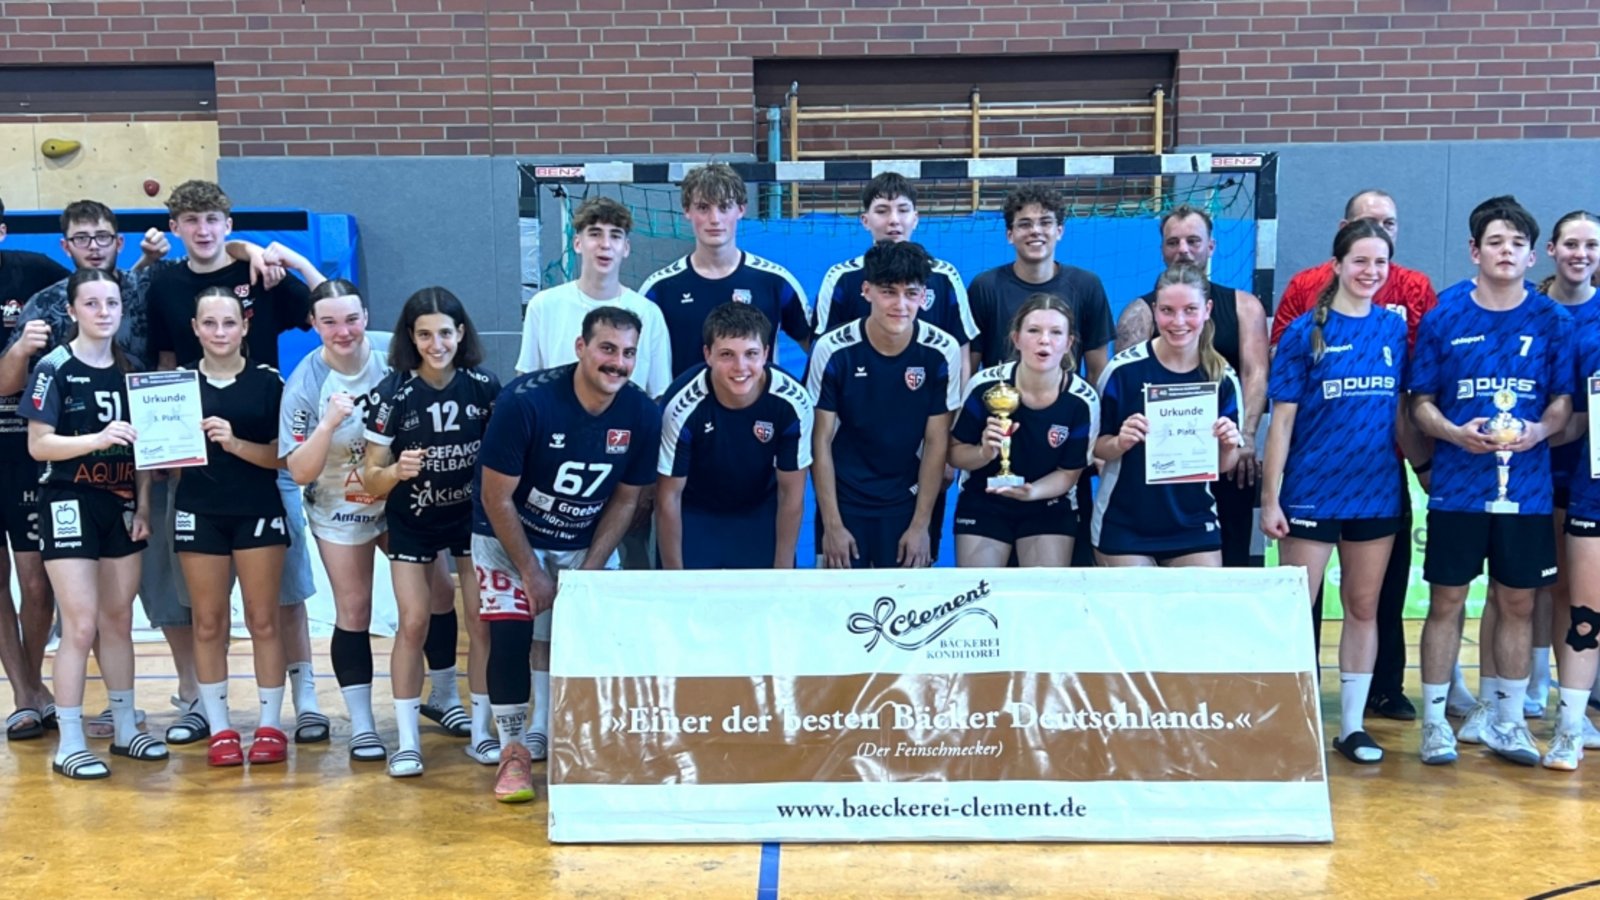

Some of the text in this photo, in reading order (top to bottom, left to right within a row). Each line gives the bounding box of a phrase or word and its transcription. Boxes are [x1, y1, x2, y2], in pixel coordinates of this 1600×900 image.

[1212, 158, 1257, 167] BENZ
[537, 168, 581, 178] BENZ
[1519, 336, 1533, 356] 7
[32, 372, 48, 399] RUPP
[1344, 376, 1396, 390] DURS
[94, 391, 122, 422] 51
[142, 393, 186, 404] Urkunde
[161, 413, 181, 422] Platz
[427, 400, 460, 432] 12
[1159, 406, 1204, 417] Urkunde
[293, 408, 308, 434] RUPP
[1177, 428, 1196, 436] Platz
[425, 439, 481, 460] GEFAKO
[553, 461, 613, 497] 67
[1290, 517, 1318, 528] Kempa
[55, 541, 82, 549] Kempa
[890, 579, 991, 637] Clement
[940, 637, 1000, 649] BÄCKEREI
[926, 648, 1000, 660] KONDITOREI
[611, 701, 1253, 733] »Einer der besten Bäcker Deutschlands.«
[857, 740, 1003, 758] (Der Feinschmecker)
[777, 797, 1087, 818] www.baeckerei-clement.de
